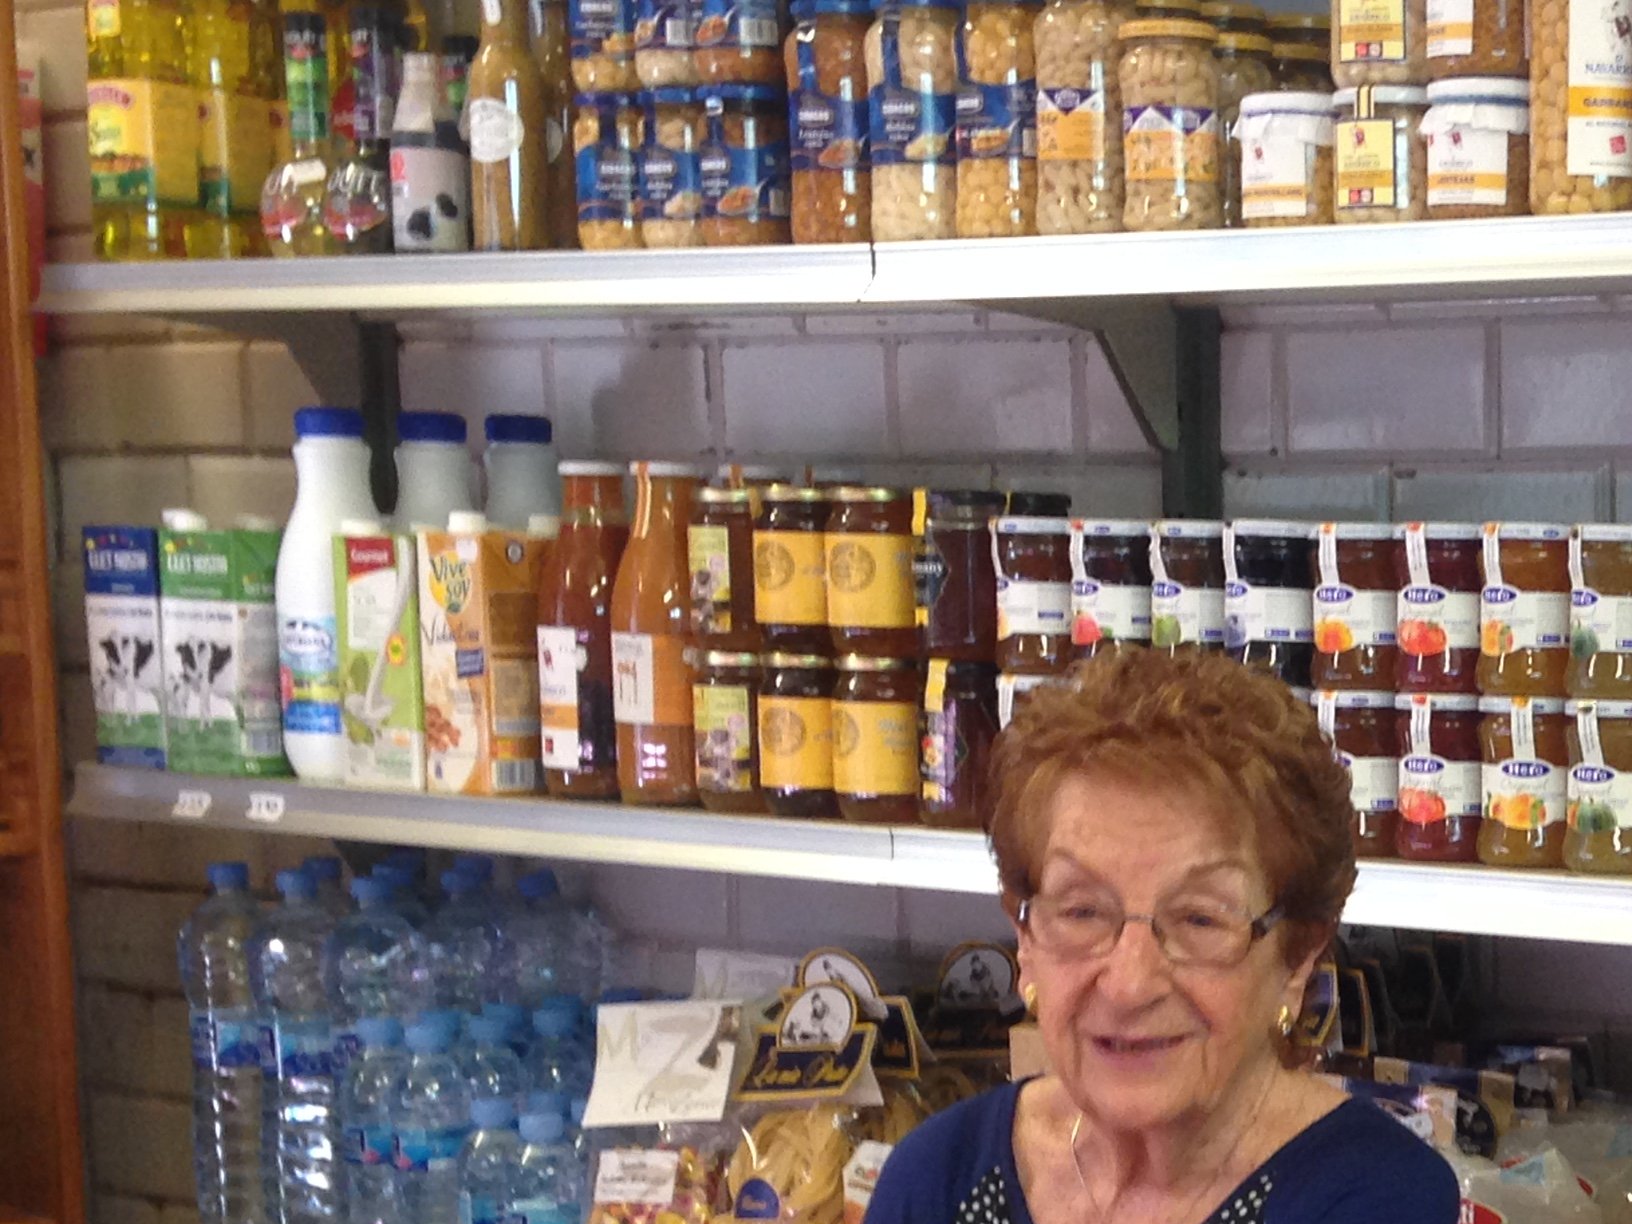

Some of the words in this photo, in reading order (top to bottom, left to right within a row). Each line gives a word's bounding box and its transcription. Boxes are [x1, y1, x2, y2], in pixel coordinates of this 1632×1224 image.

[429, 556, 466, 582] Vive
[1319, 588, 1348, 601] Hero
[1407, 588, 1440, 602] Hero
[1408, 760, 1438, 774] Hero
[1506, 762, 1544, 778] Hero
[1576, 767, 1609, 782] Hero
